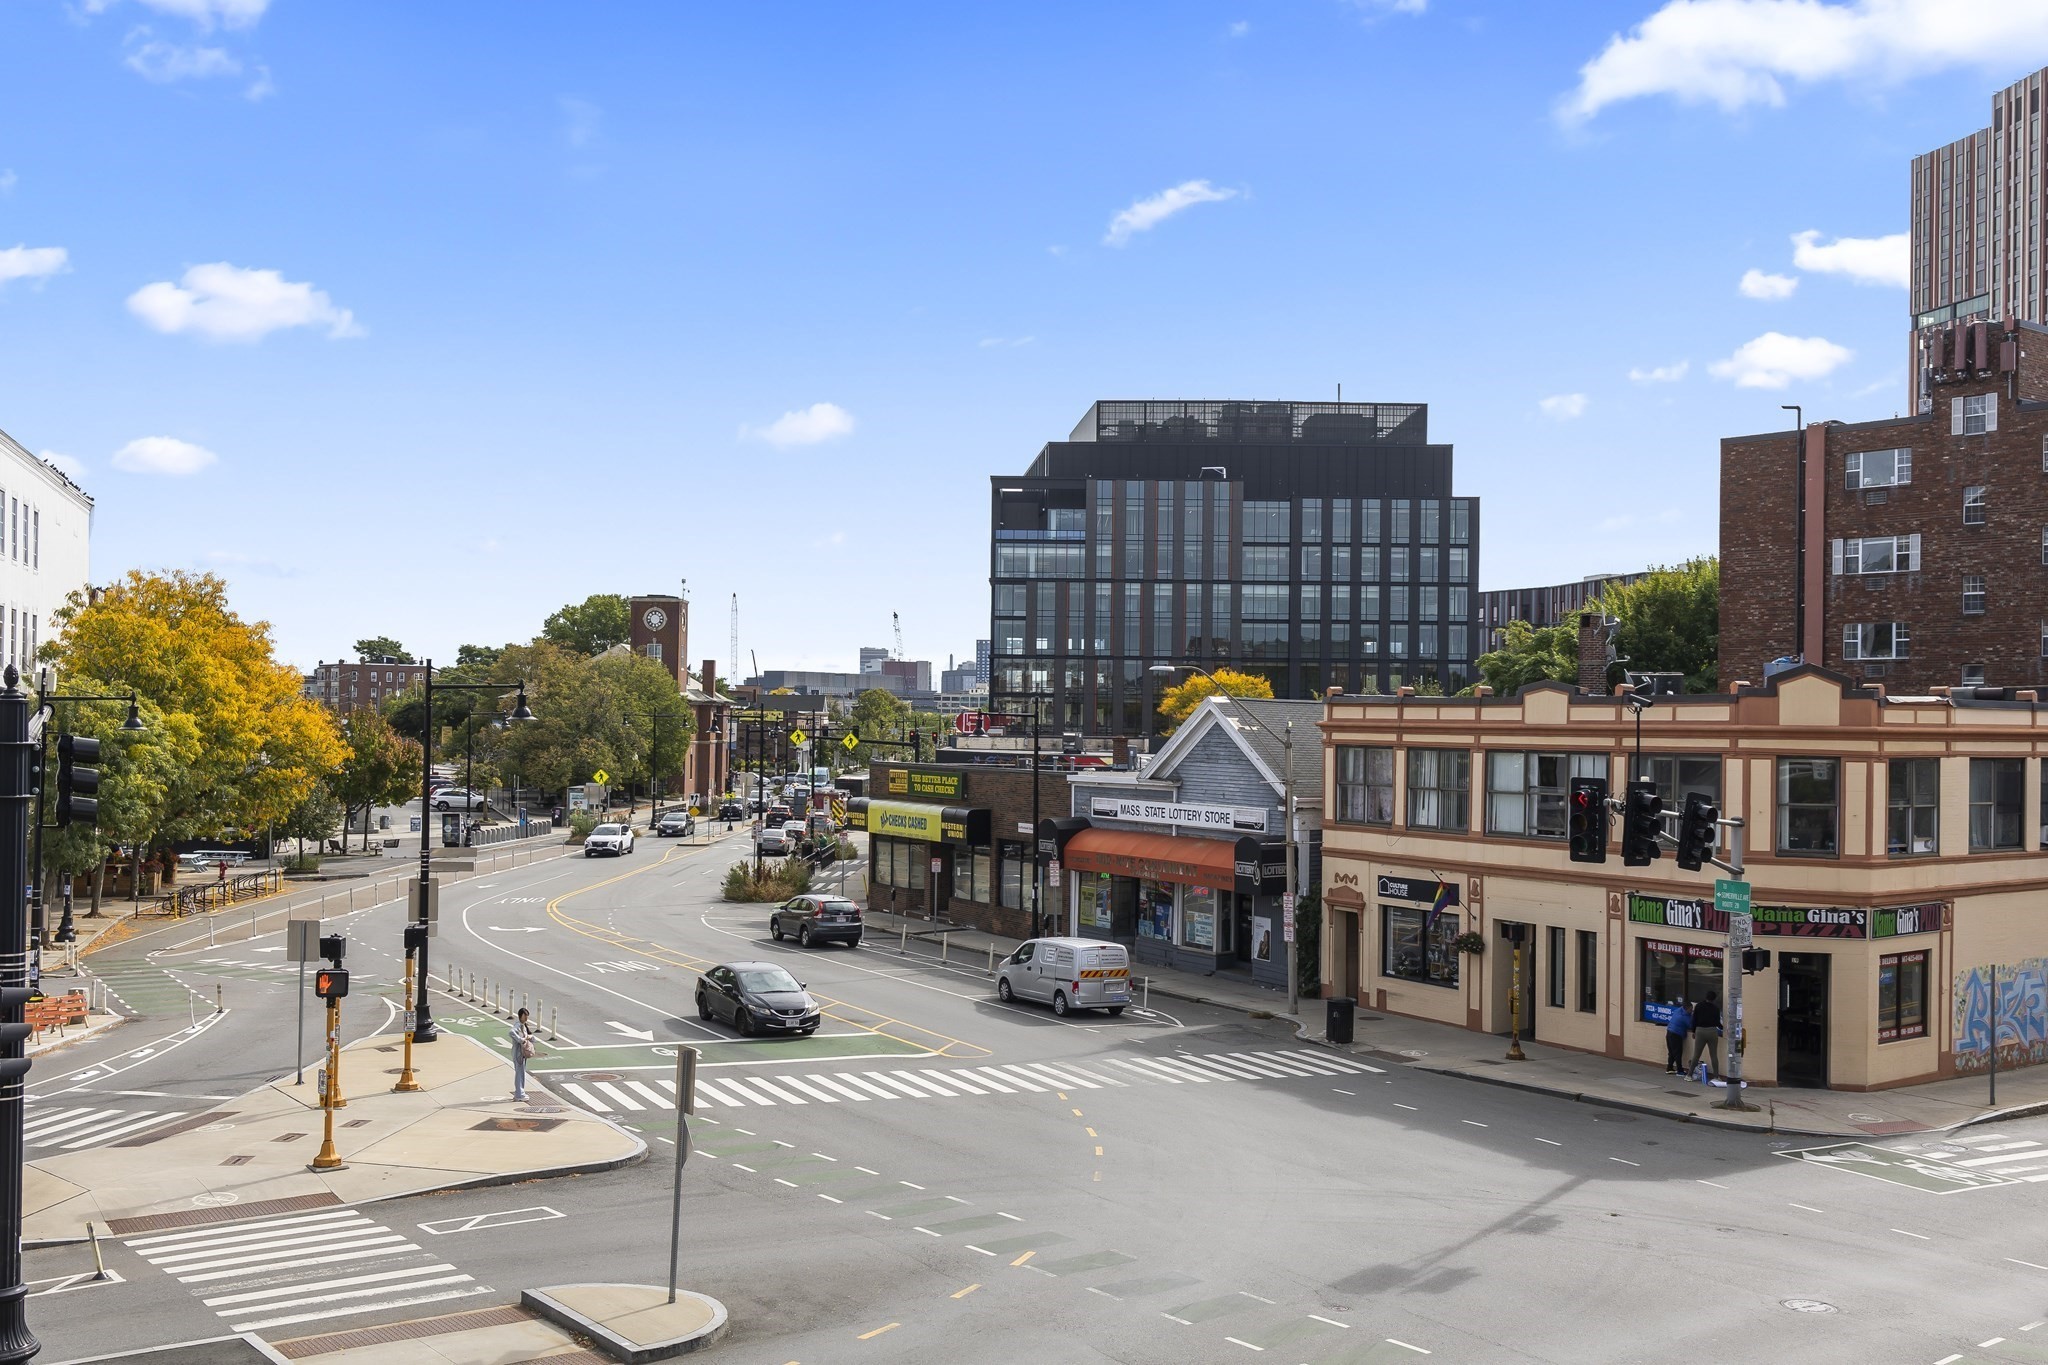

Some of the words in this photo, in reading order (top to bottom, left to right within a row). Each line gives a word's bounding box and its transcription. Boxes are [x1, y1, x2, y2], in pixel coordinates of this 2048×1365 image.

[911, 774, 921, 782] THE
[921, 775, 941, 784] BETTER
[942, 776, 958, 785] PLACE
[922, 784, 934, 793] CASH
[935, 785, 955, 794] CHECKS
[880, 810, 889, 828] ALL
[888, 815, 907, 829] CHECKS
[907, 816, 927, 830] CASHED
[1120, 804, 1142, 816] MASS.
[1145, 806, 1166, 819] STATE
[1168, 808, 1202, 822] LOTTERY
[1204, 811, 1231, 825] STORE
[941, 822, 964, 831] WESTERN
[948, 830, 964, 839] UNION
[1236, 863, 1254, 874] LOTTERY
[1264, 865, 1287, 875] LOTTER
[1390, 882, 1408, 890] CULTURE
[1390, 888, 1408, 897] HOUSE
[1721, 892, 1742, 900] SOMERVILLE
[1631, 896, 1664, 924] Mama
[1666, 899, 1701, 928] Gina's
[1704, 903, 1729, 932] PIZZ
[1751, 907, 1805, 922] Mama
[1807, 909, 1864, 924] Gina's
[1873, 910, 1896, 938] Mama
[1897, 907, 1919, 935] Gina's
[1920, 904, 1940, 931] PIZZA
[1752, 922, 1864, 938] PIZZA
[1647, 941, 1656, 949] WE
[1657, 942, 1682, 953] DELIVER
[1689, 947, 1723, 958] 617-625-011
[584, 960, 661, 973] ONLY
[1882, 957, 1898, 965] DELIVER
